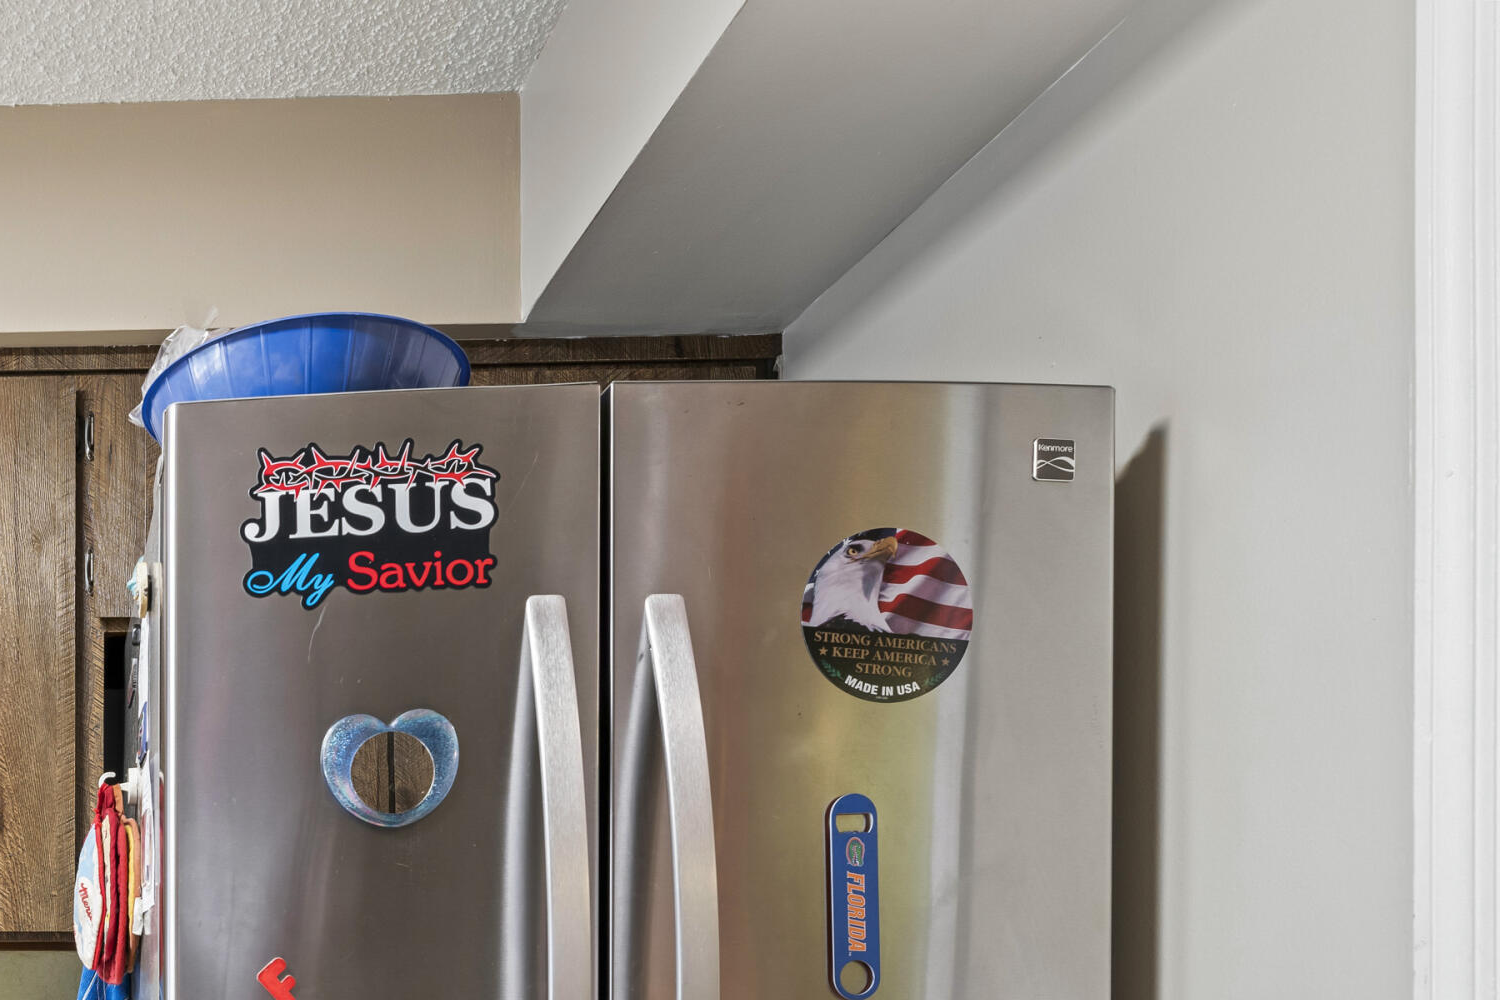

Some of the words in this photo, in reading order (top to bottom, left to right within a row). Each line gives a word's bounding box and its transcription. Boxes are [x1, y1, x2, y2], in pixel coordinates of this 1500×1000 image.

[1038, 444, 1073, 452] Kenmore
[244, 478, 495, 543] JESUS
[247, 552, 334, 607] My
[347, 551, 493, 589] Savior
[814, 631, 871, 647] STRONG
[874, 637, 957, 653] AMERICANS
[832, 647, 870, 660] KEEP
[872, 651, 937, 666] AMERICA
[855, 662, 912, 678] STRONG
[844, 675, 878, 695] MADE
[881, 686, 894, 697] IN
[897, 681, 920, 696] USA
[846, 870, 867, 952] FLORIDA
